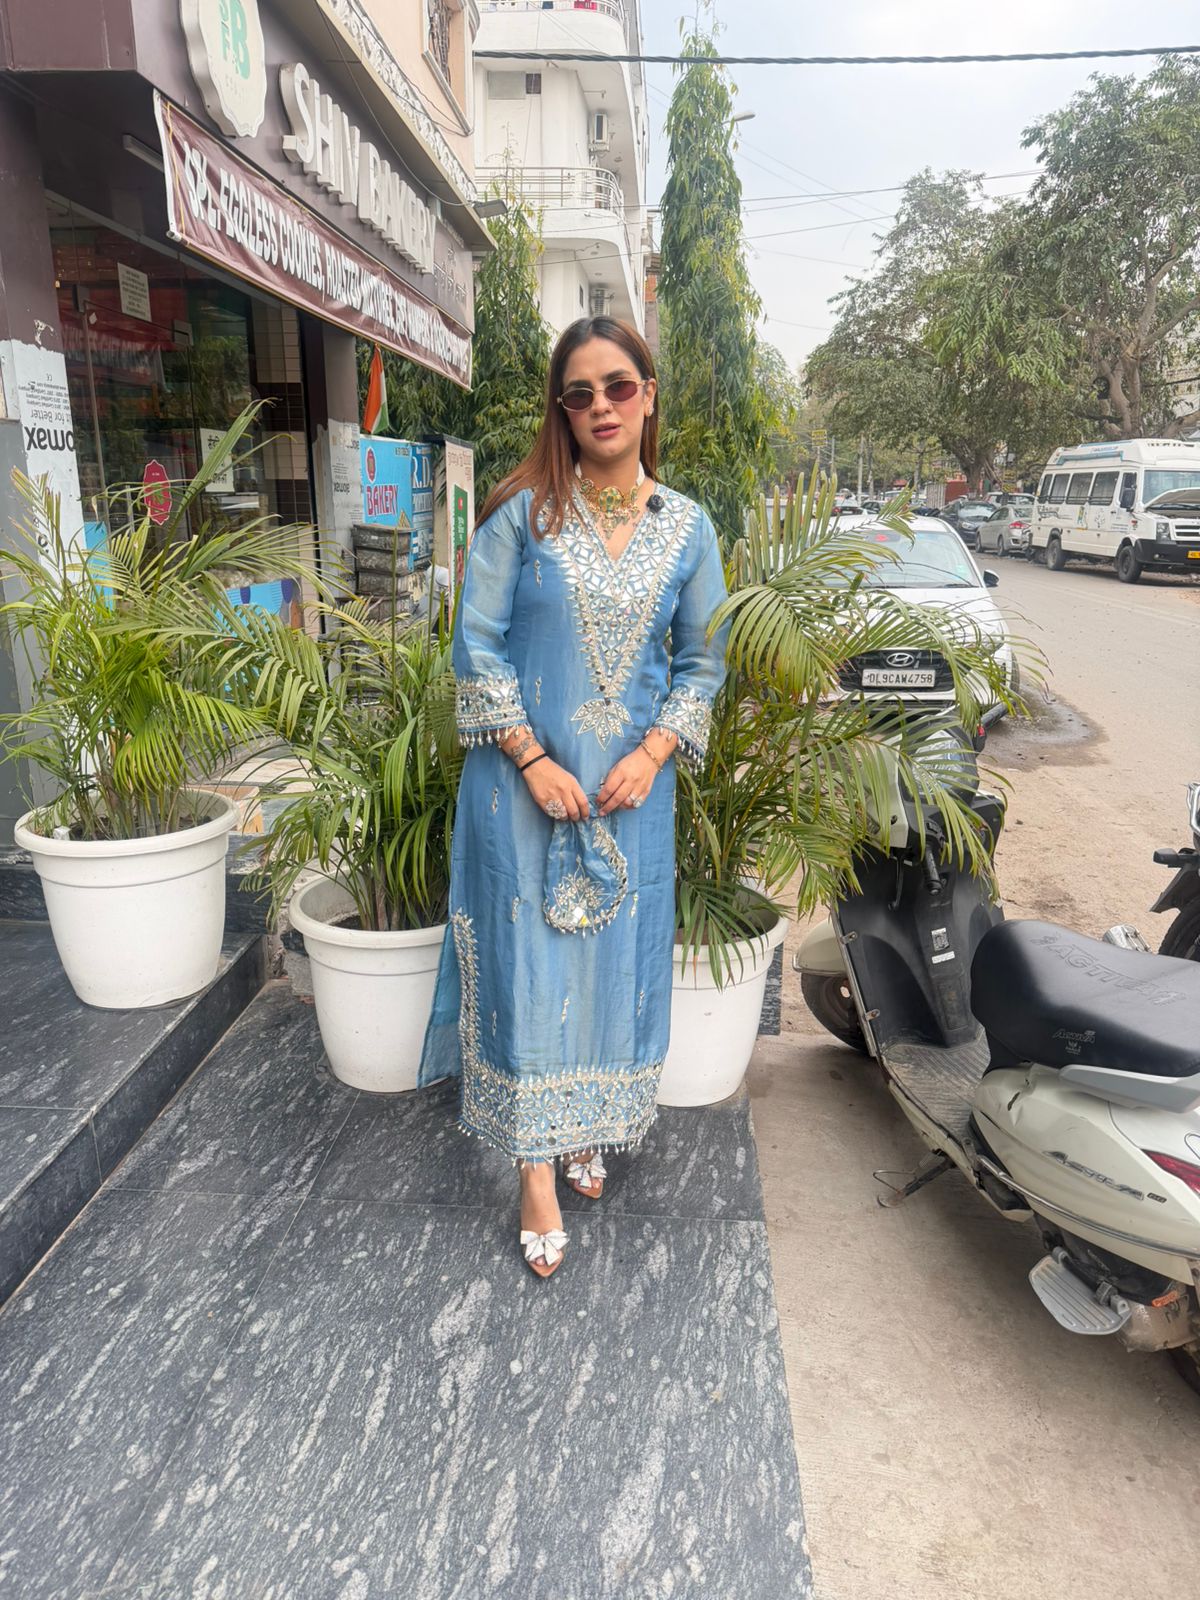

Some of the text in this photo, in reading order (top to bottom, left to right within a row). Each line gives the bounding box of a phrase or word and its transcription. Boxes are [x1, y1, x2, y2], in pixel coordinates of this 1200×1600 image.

[279, 62, 437, 275] SHIV BAKERY
[219, 168, 278, 266] EGGLESS
[279, 208, 325, 292] COOKIES,
[325, 243, 361, 310] ROASTED
[31, 409, 53, 423] Better
[366, 485, 398, 516] BAKERY
